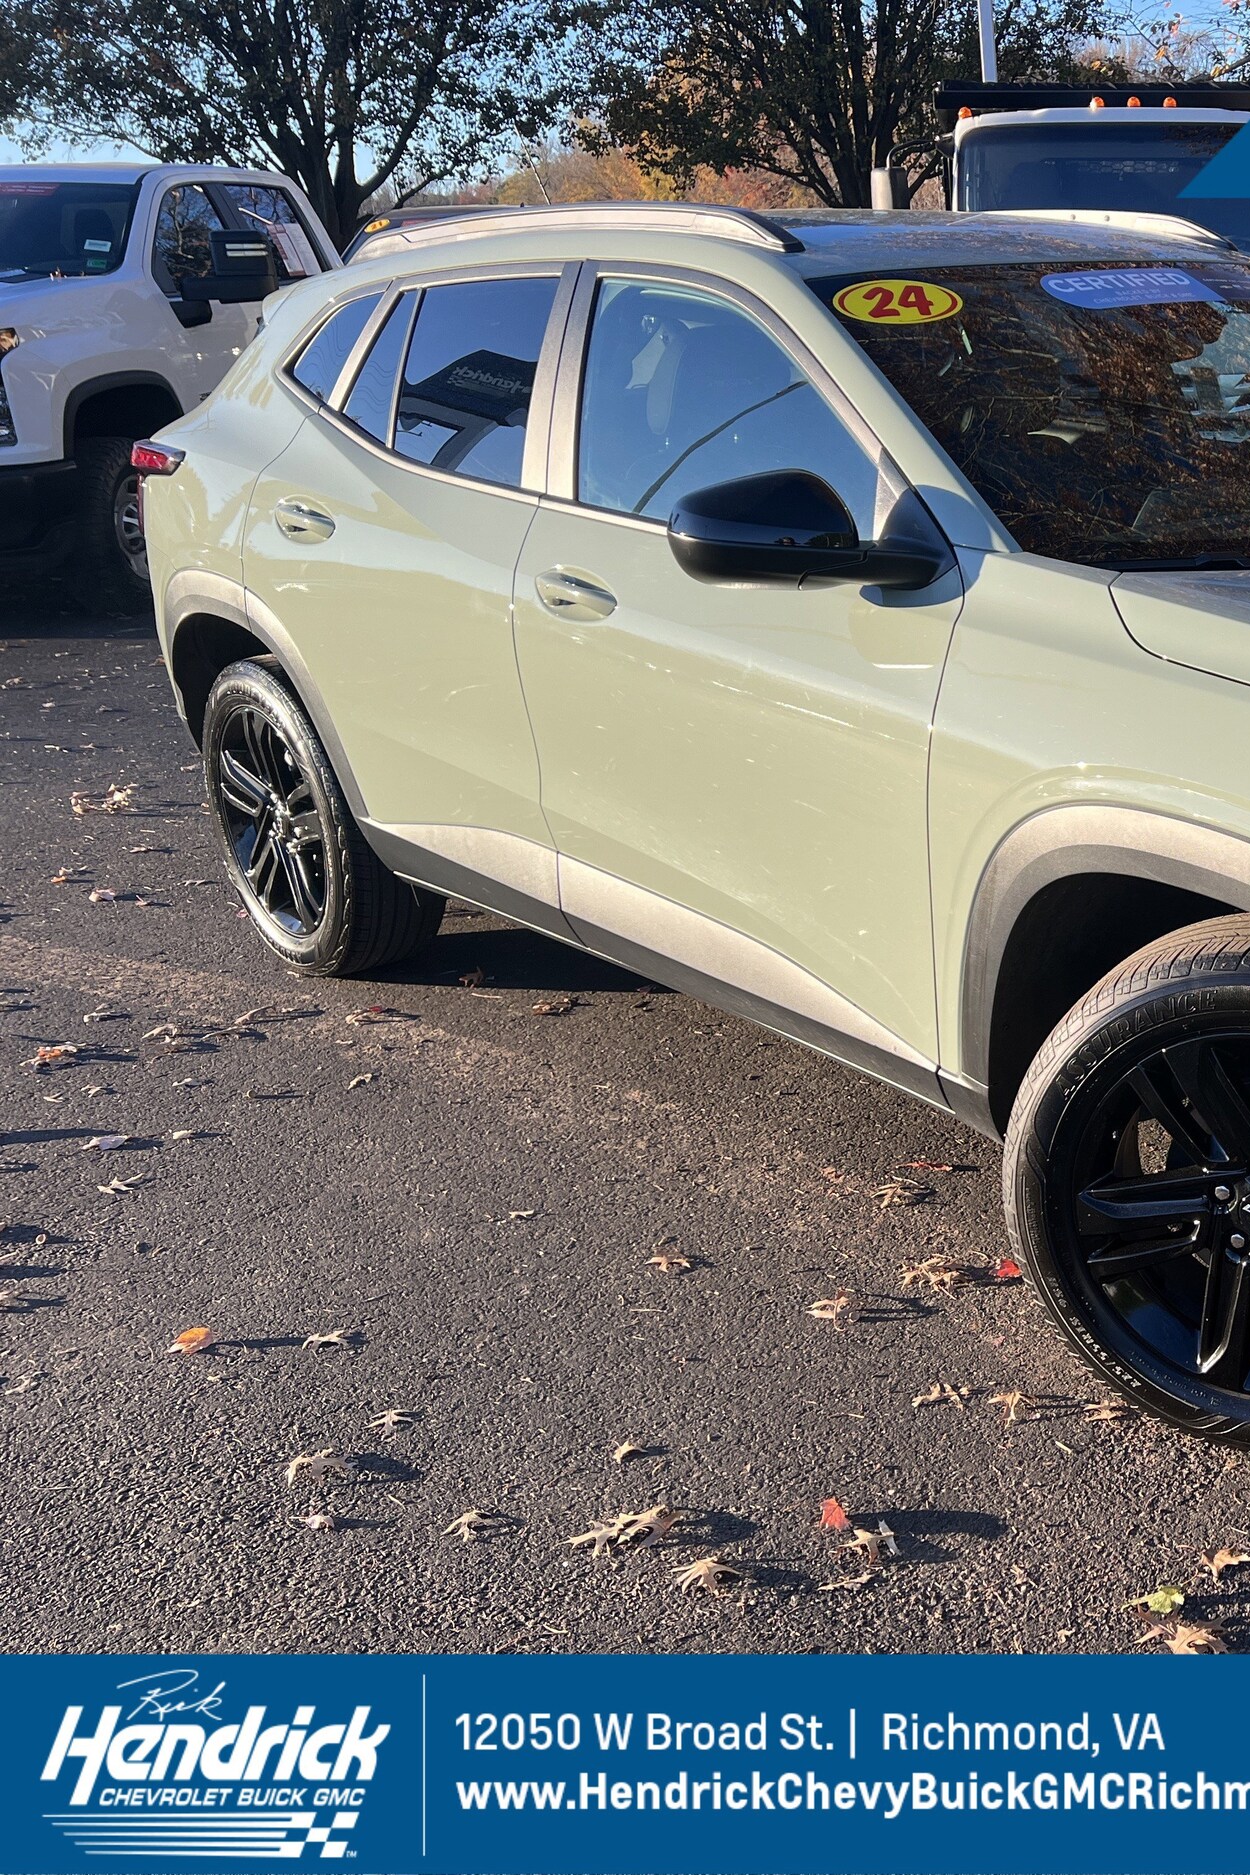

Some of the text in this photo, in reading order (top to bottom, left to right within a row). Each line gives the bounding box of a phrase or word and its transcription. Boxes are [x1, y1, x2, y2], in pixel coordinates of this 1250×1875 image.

[1047, 272, 1191, 293] CERTIFIED
[862, 285, 934, 318] 24
[1055, 990, 1218, 1100] ASSURANCE
